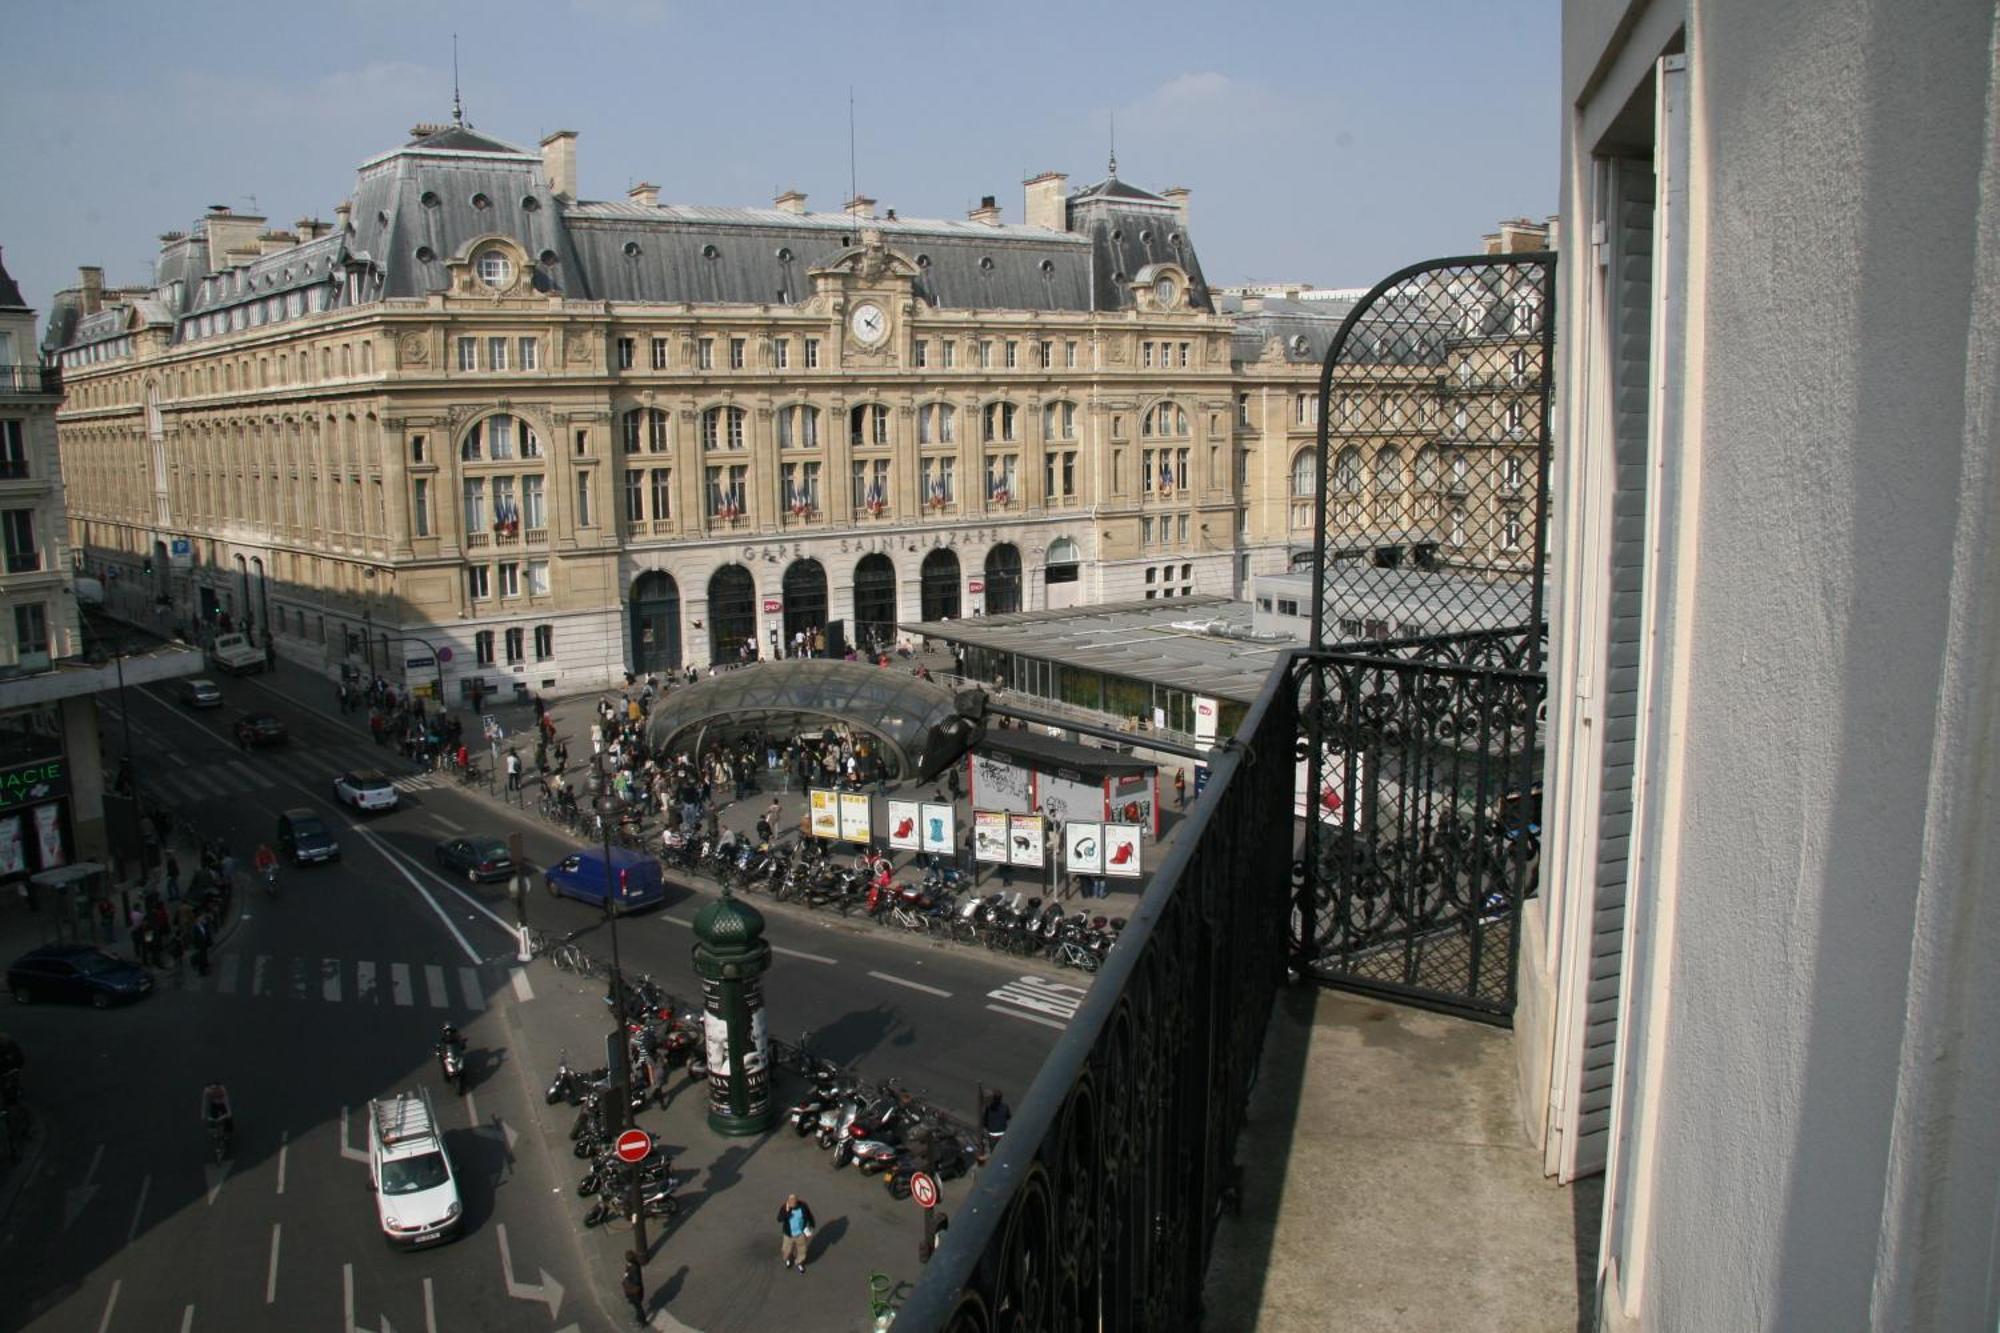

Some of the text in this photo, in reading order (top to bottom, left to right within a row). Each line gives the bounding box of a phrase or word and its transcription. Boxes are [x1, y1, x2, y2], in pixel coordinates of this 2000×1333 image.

[743, 543, 801, 561] GARE
[922, 529, 998, 548] LAZARE
[0, 764, 62, 789] ACIE
